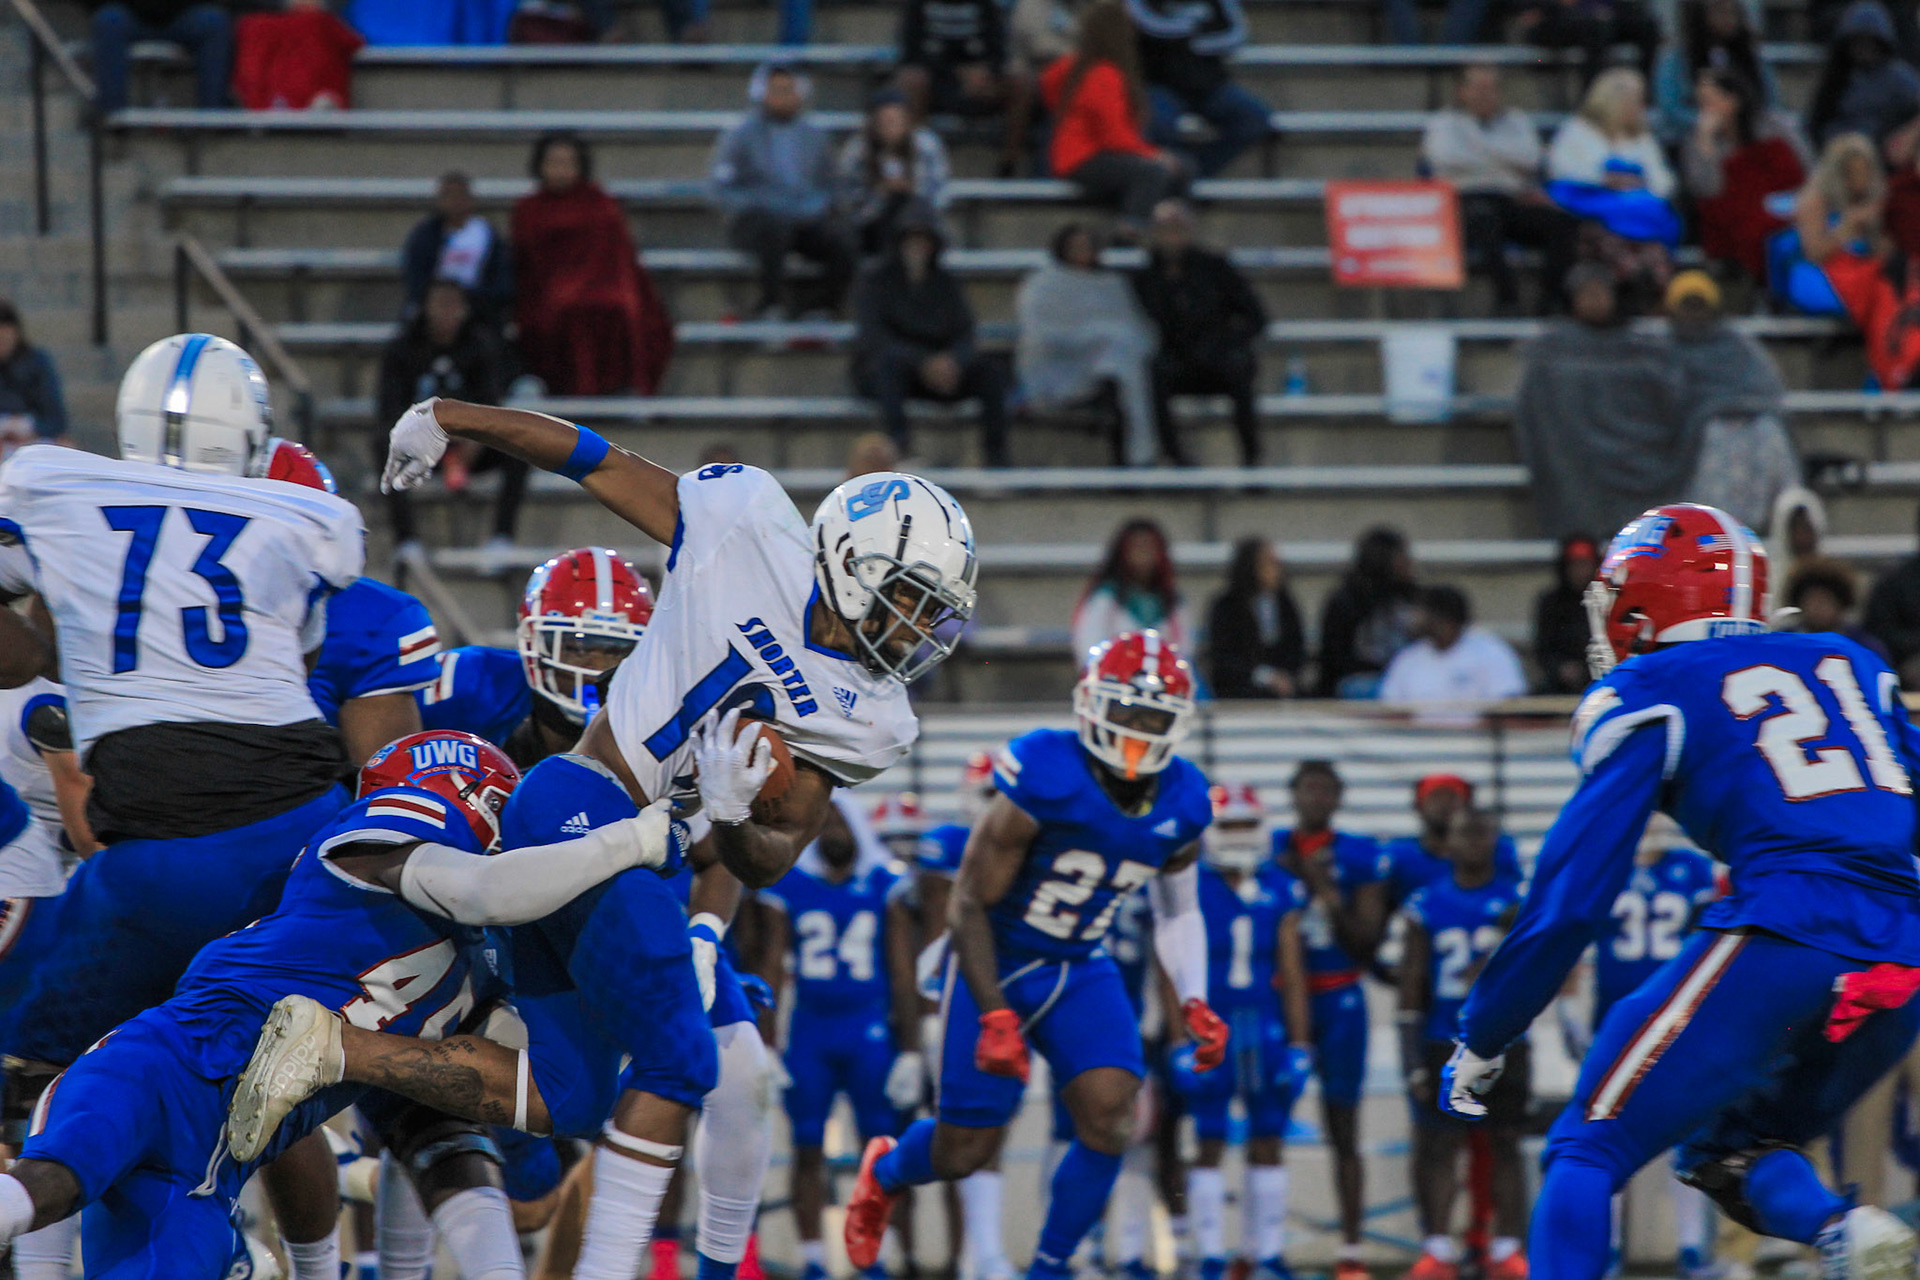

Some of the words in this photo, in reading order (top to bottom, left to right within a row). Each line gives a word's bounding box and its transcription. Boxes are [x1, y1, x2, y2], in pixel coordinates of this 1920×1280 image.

[98, 505, 254, 674] 73
[734, 617, 819, 718] SHORTER
[412, 740, 477, 770] UWG
[1719, 653, 1914, 803] 21
[1022, 848, 1158, 942] 27
[1610, 890, 1689, 961] 32
[796, 909, 878, 981] 24
[1228, 914, 1254, 990] 1
[268, 1034, 316, 1099] adidas
